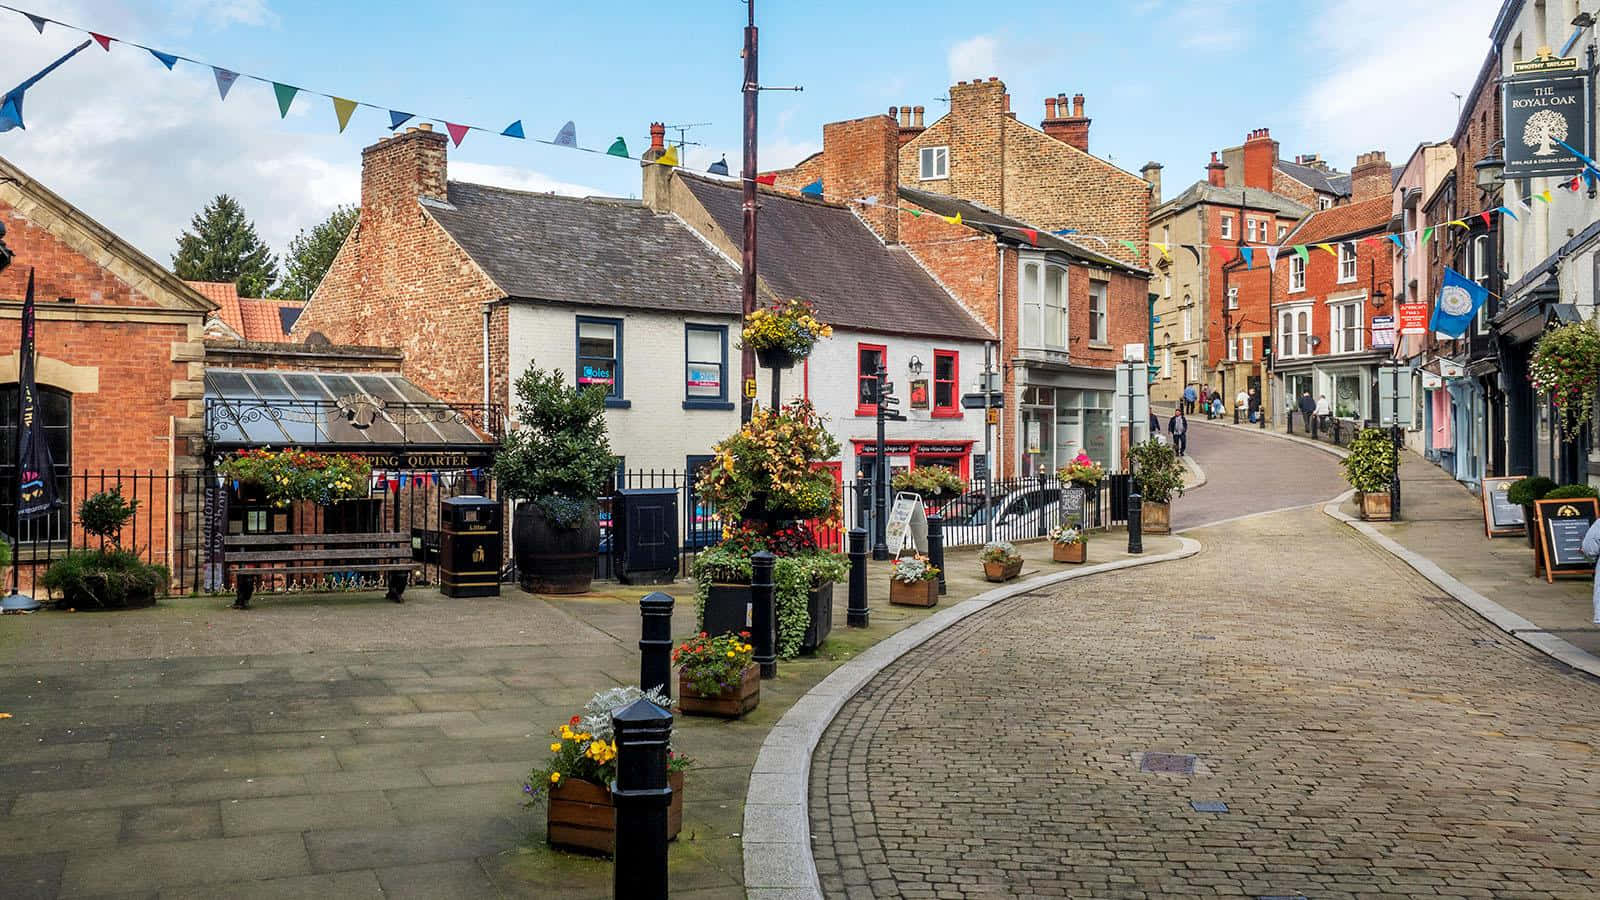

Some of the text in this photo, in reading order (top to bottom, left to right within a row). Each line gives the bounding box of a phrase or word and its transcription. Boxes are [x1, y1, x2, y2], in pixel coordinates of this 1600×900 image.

[1533, 86, 1555, 96] THE
[1511, 95, 1577, 109] ROYAL OAK
[408, 455, 469, 467] QUARTER
